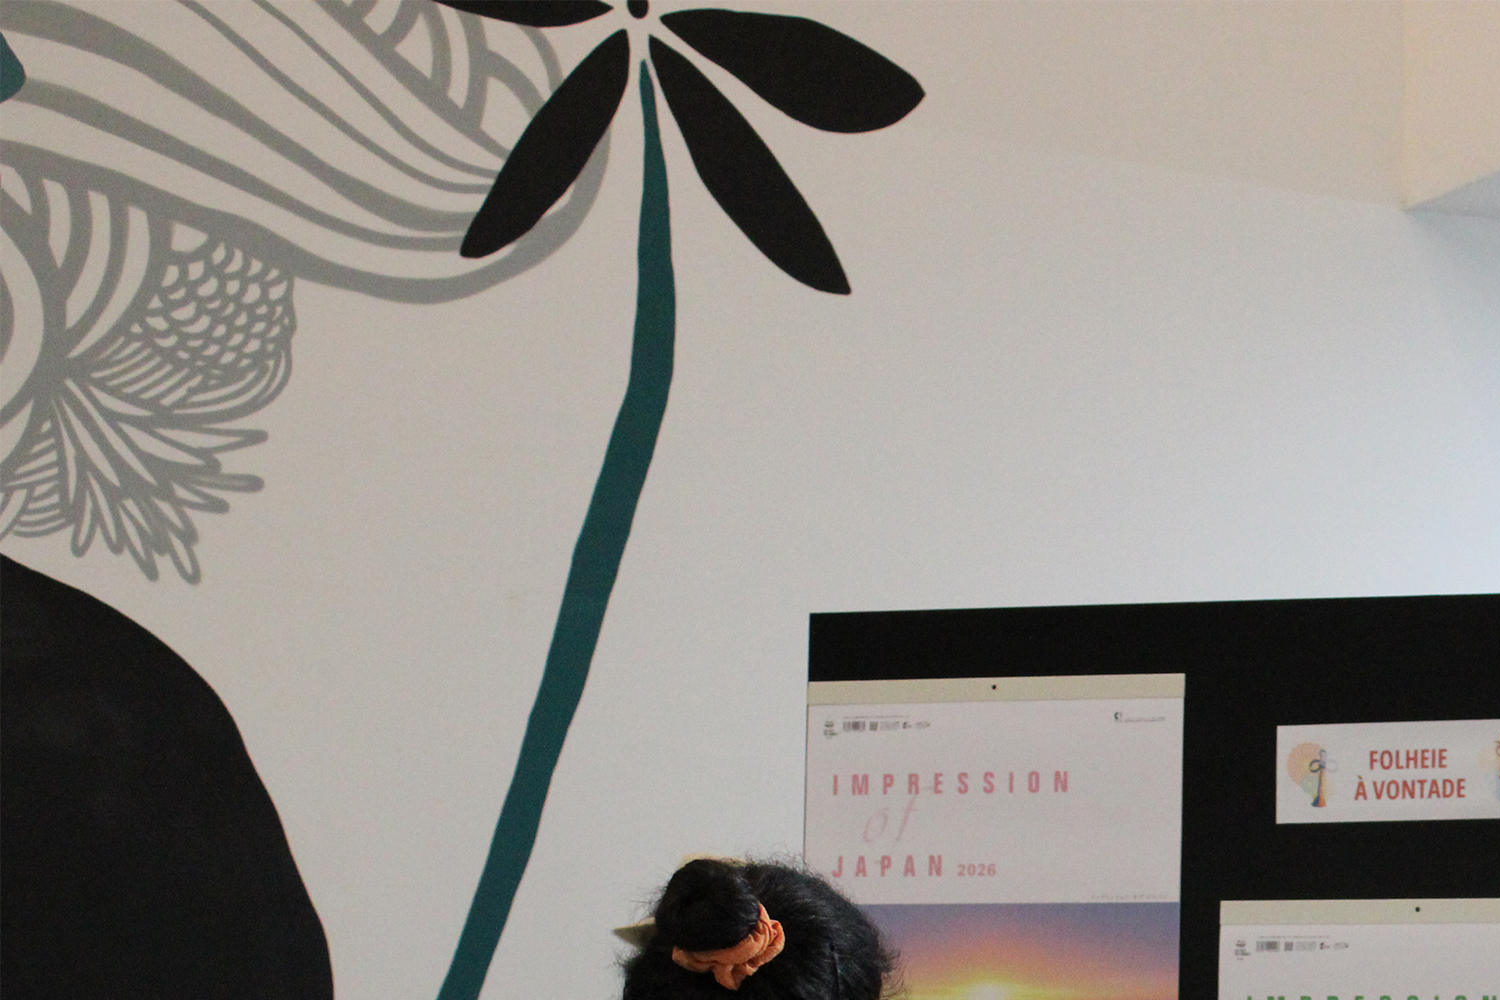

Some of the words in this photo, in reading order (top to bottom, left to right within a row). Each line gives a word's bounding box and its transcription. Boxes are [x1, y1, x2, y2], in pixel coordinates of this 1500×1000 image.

[1369, 749, 1448, 771] FOLHEIE
[832, 770, 1070, 796] IMPRESSION
[1354, 775, 1368, 801] À
[1372, 778, 1466, 801] VONTADE
[831, 855, 943, 879] JAPAN
[957, 863, 997, 878] 2026
